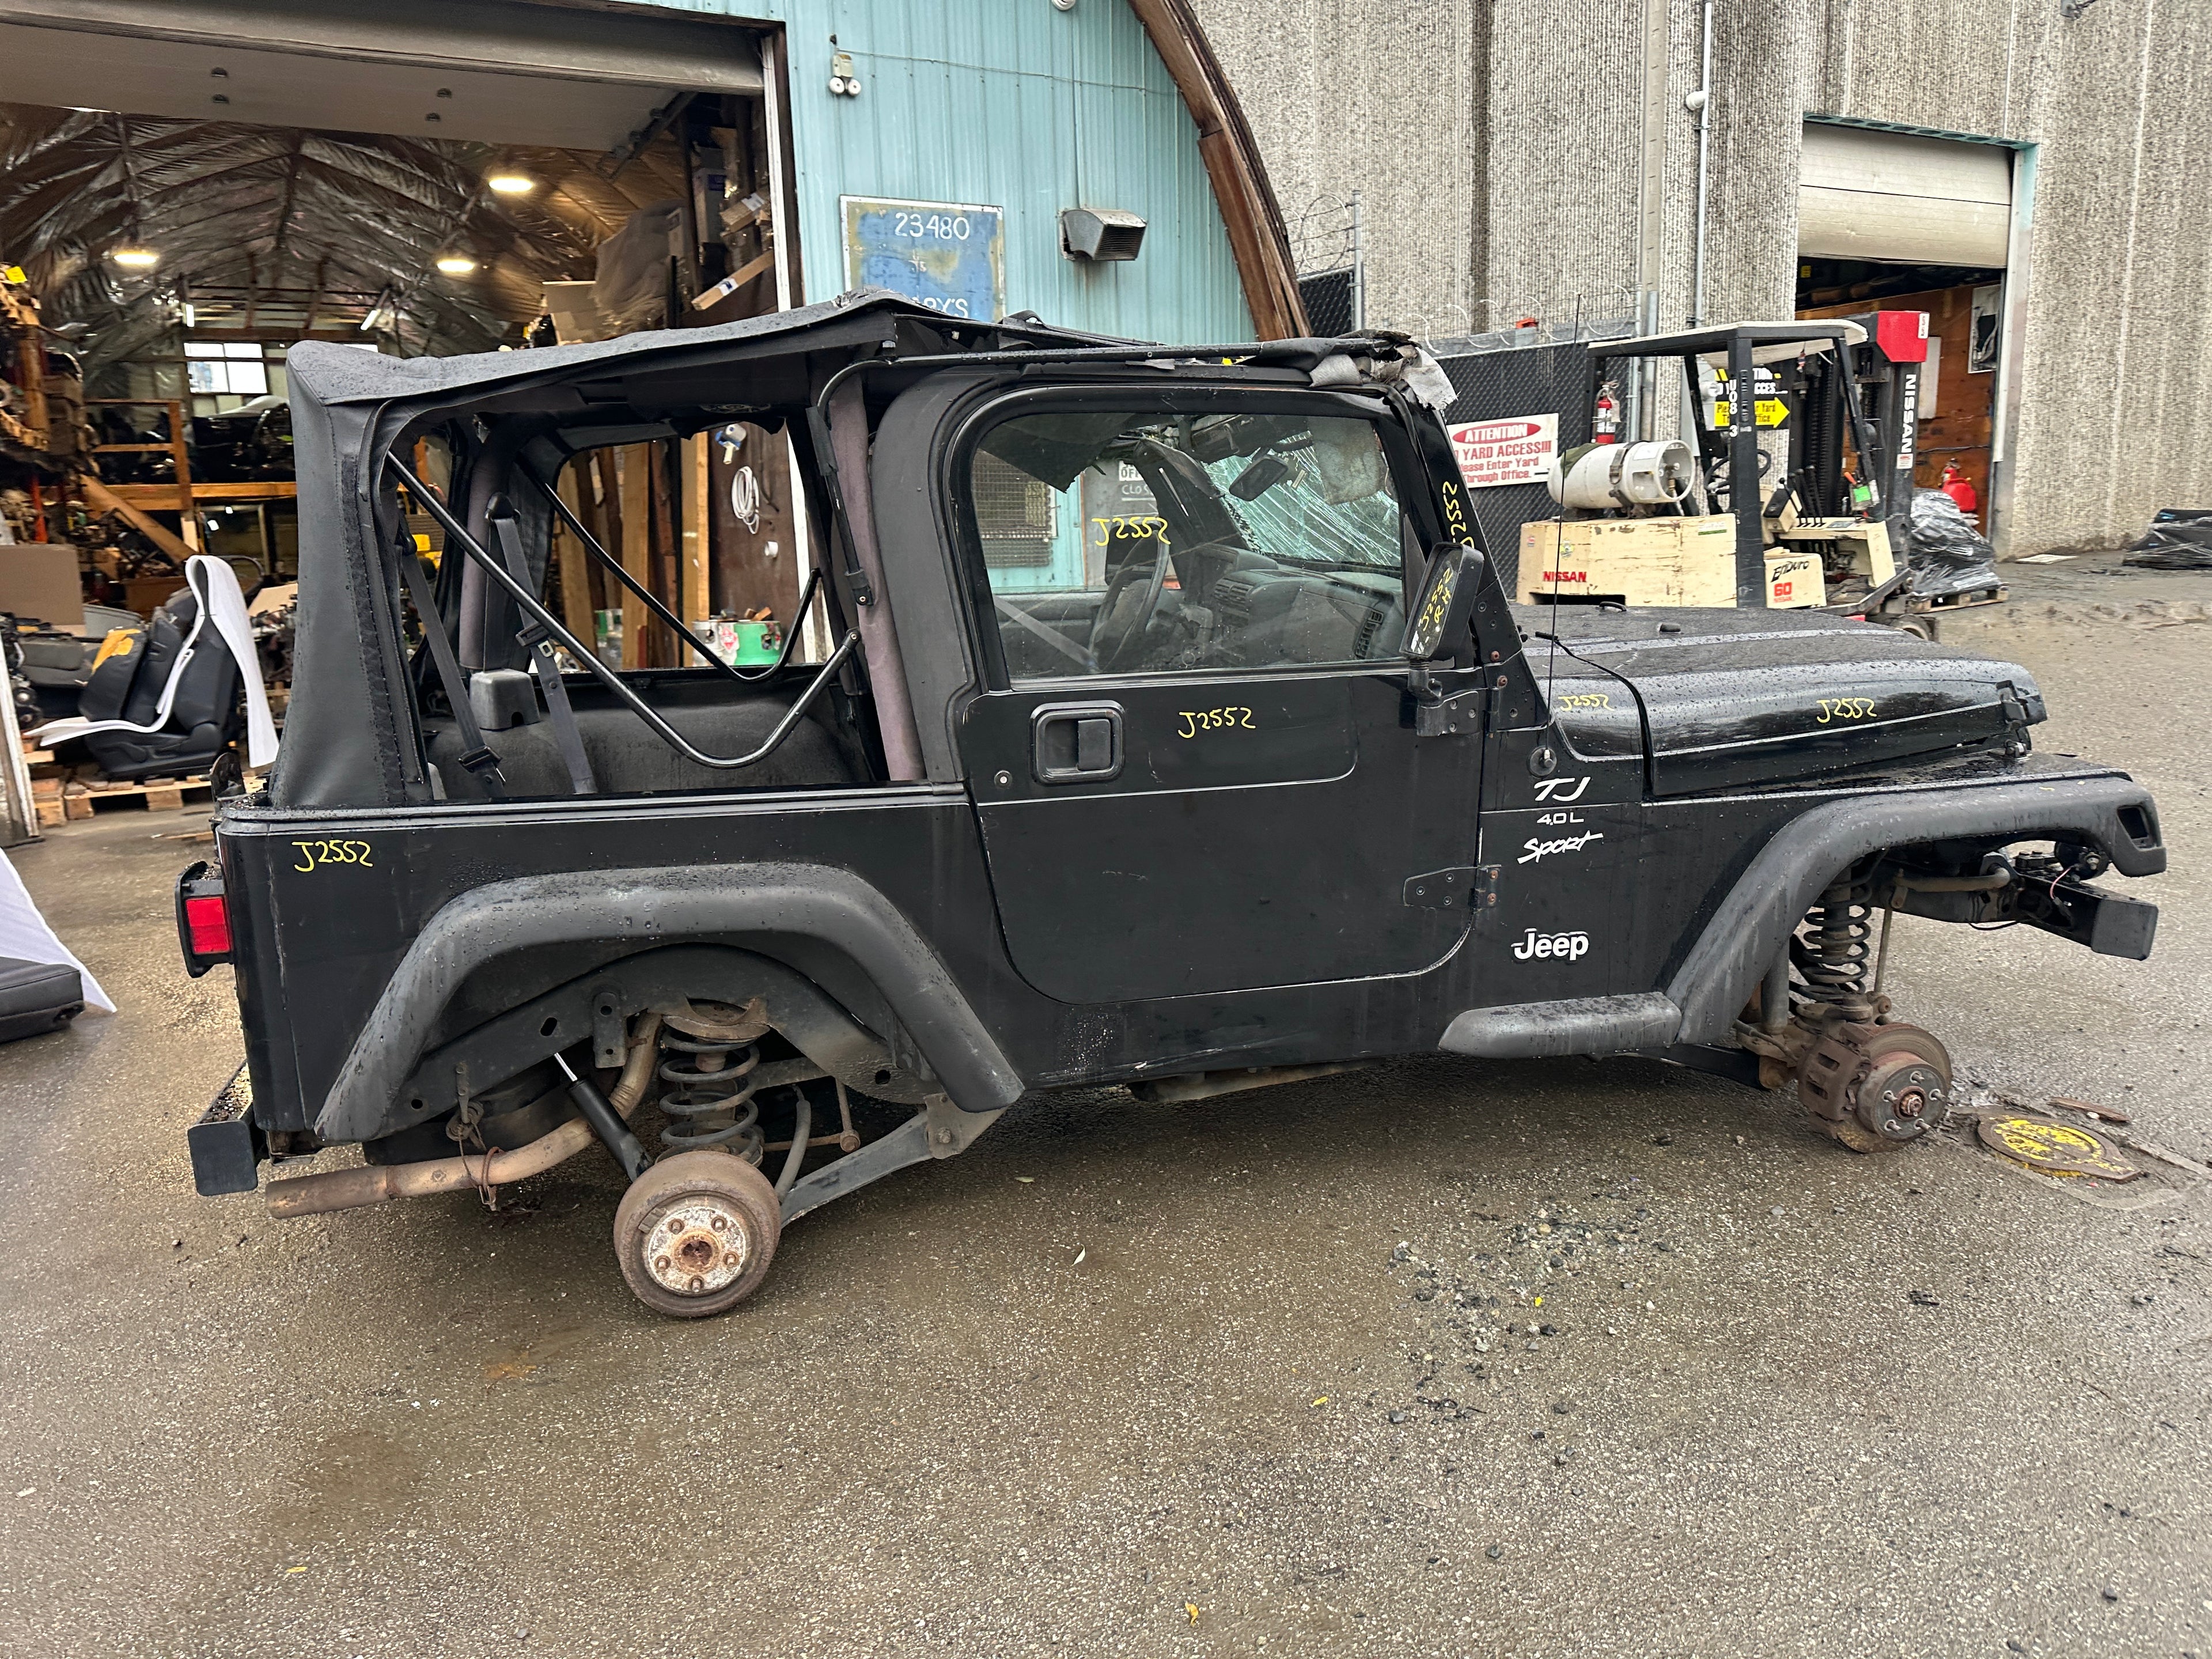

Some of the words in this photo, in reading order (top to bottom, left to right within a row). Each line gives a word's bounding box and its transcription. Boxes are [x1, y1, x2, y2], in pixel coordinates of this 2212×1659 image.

[895, 212, 970, 240] 23480
[1901, 374, 1917, 453] NISSAN
[1464, 423, 1528, 443] ATTENTION
[1461, 461, 1484, 472] lease
[1487, 459, 1513, 472] Enter
[1515, 456, 1539, 468] Yard
[1463, 446, 1493, 461] YARD
[1091, 516, 1172, 547] J2552
[1542, 571, 1588, 583] NISSAN
[1774, 582, 1792, 596] 60
[1421, 567, 1453, 632] J2552
[1558, 694, 1615, 711] J2552
[1816, 697, 1878, 724] J2552
[1177, 707, 1256, 738] J2552
[1533, 777, 1591, 802] TJ
[291, 839, 373, 872] J2552
[1511, 928, 1589, 961] Jeep
